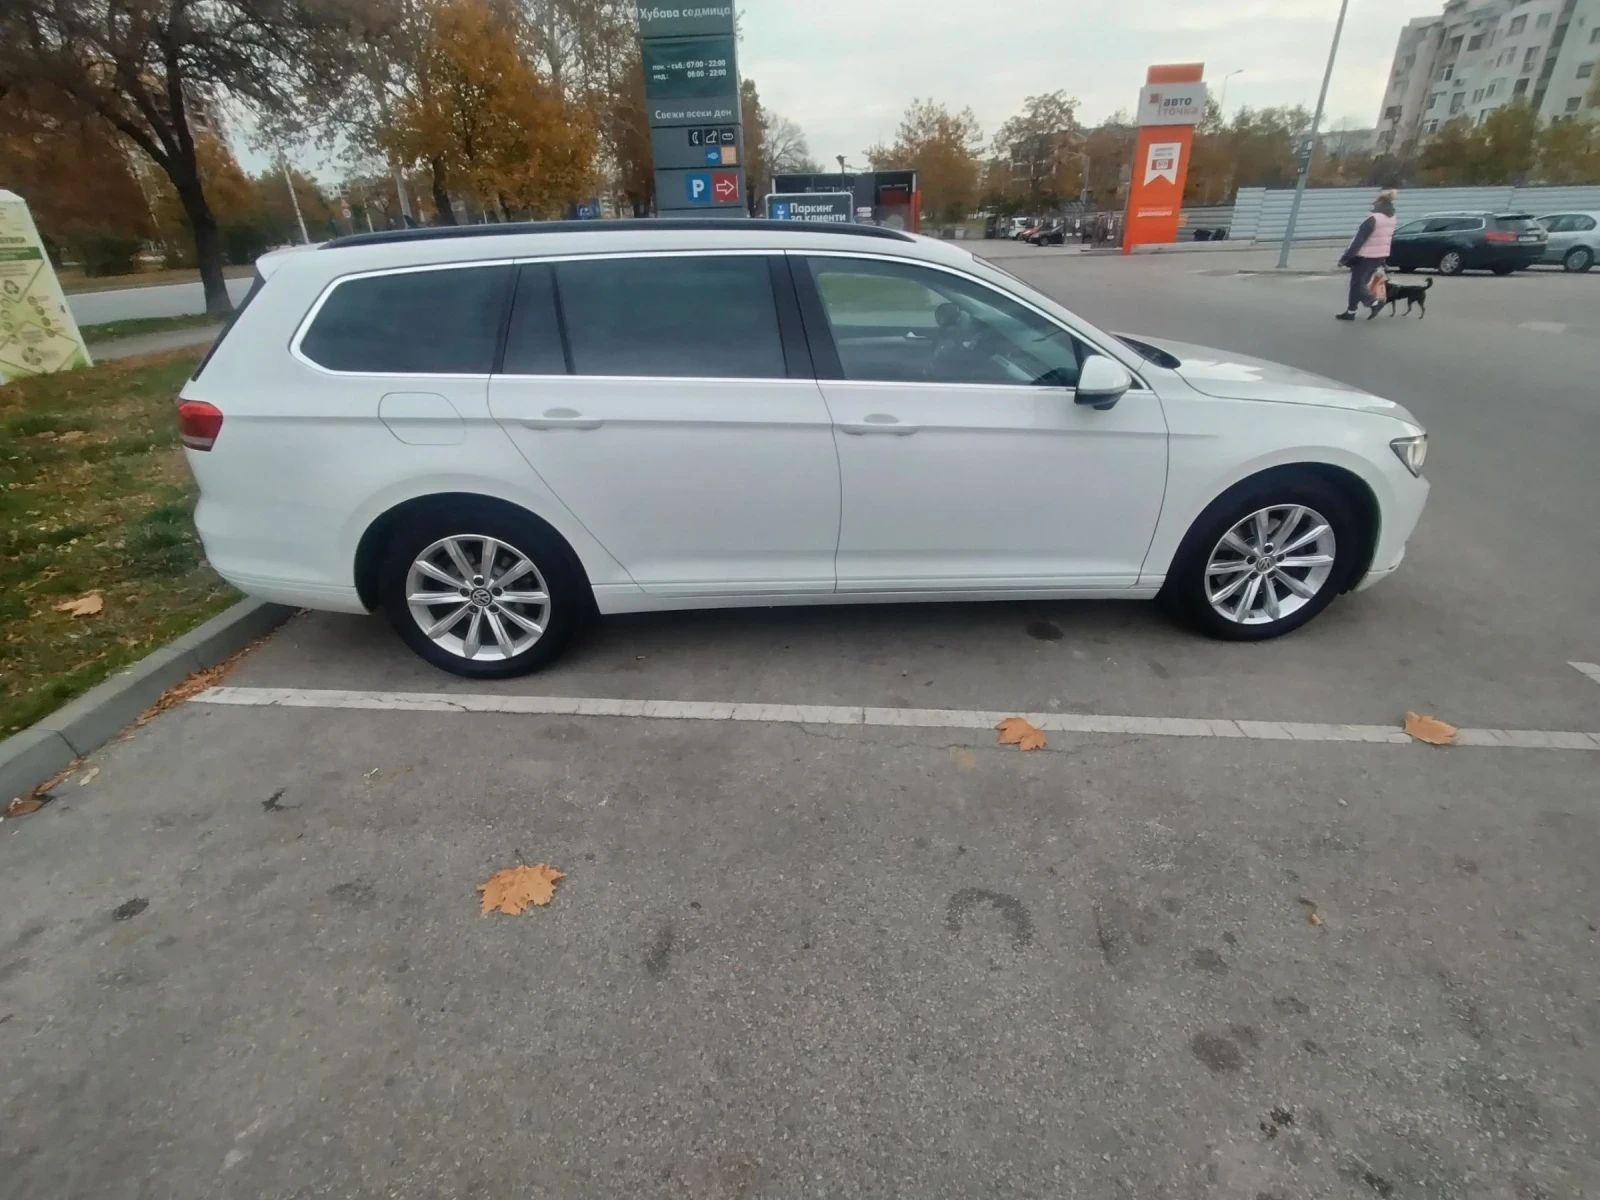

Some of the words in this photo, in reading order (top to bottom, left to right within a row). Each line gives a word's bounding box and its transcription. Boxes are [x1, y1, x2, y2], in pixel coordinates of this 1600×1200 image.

[640, 7, 680, 22] Хубава
[682, 6, 731, 18] седмица
[655, 110, 684, 120] Свежи
[686, 110, 712, 118] всеки
[713, 109, 732, 119] ден
[790, 203, 833, 214] Паркинг
